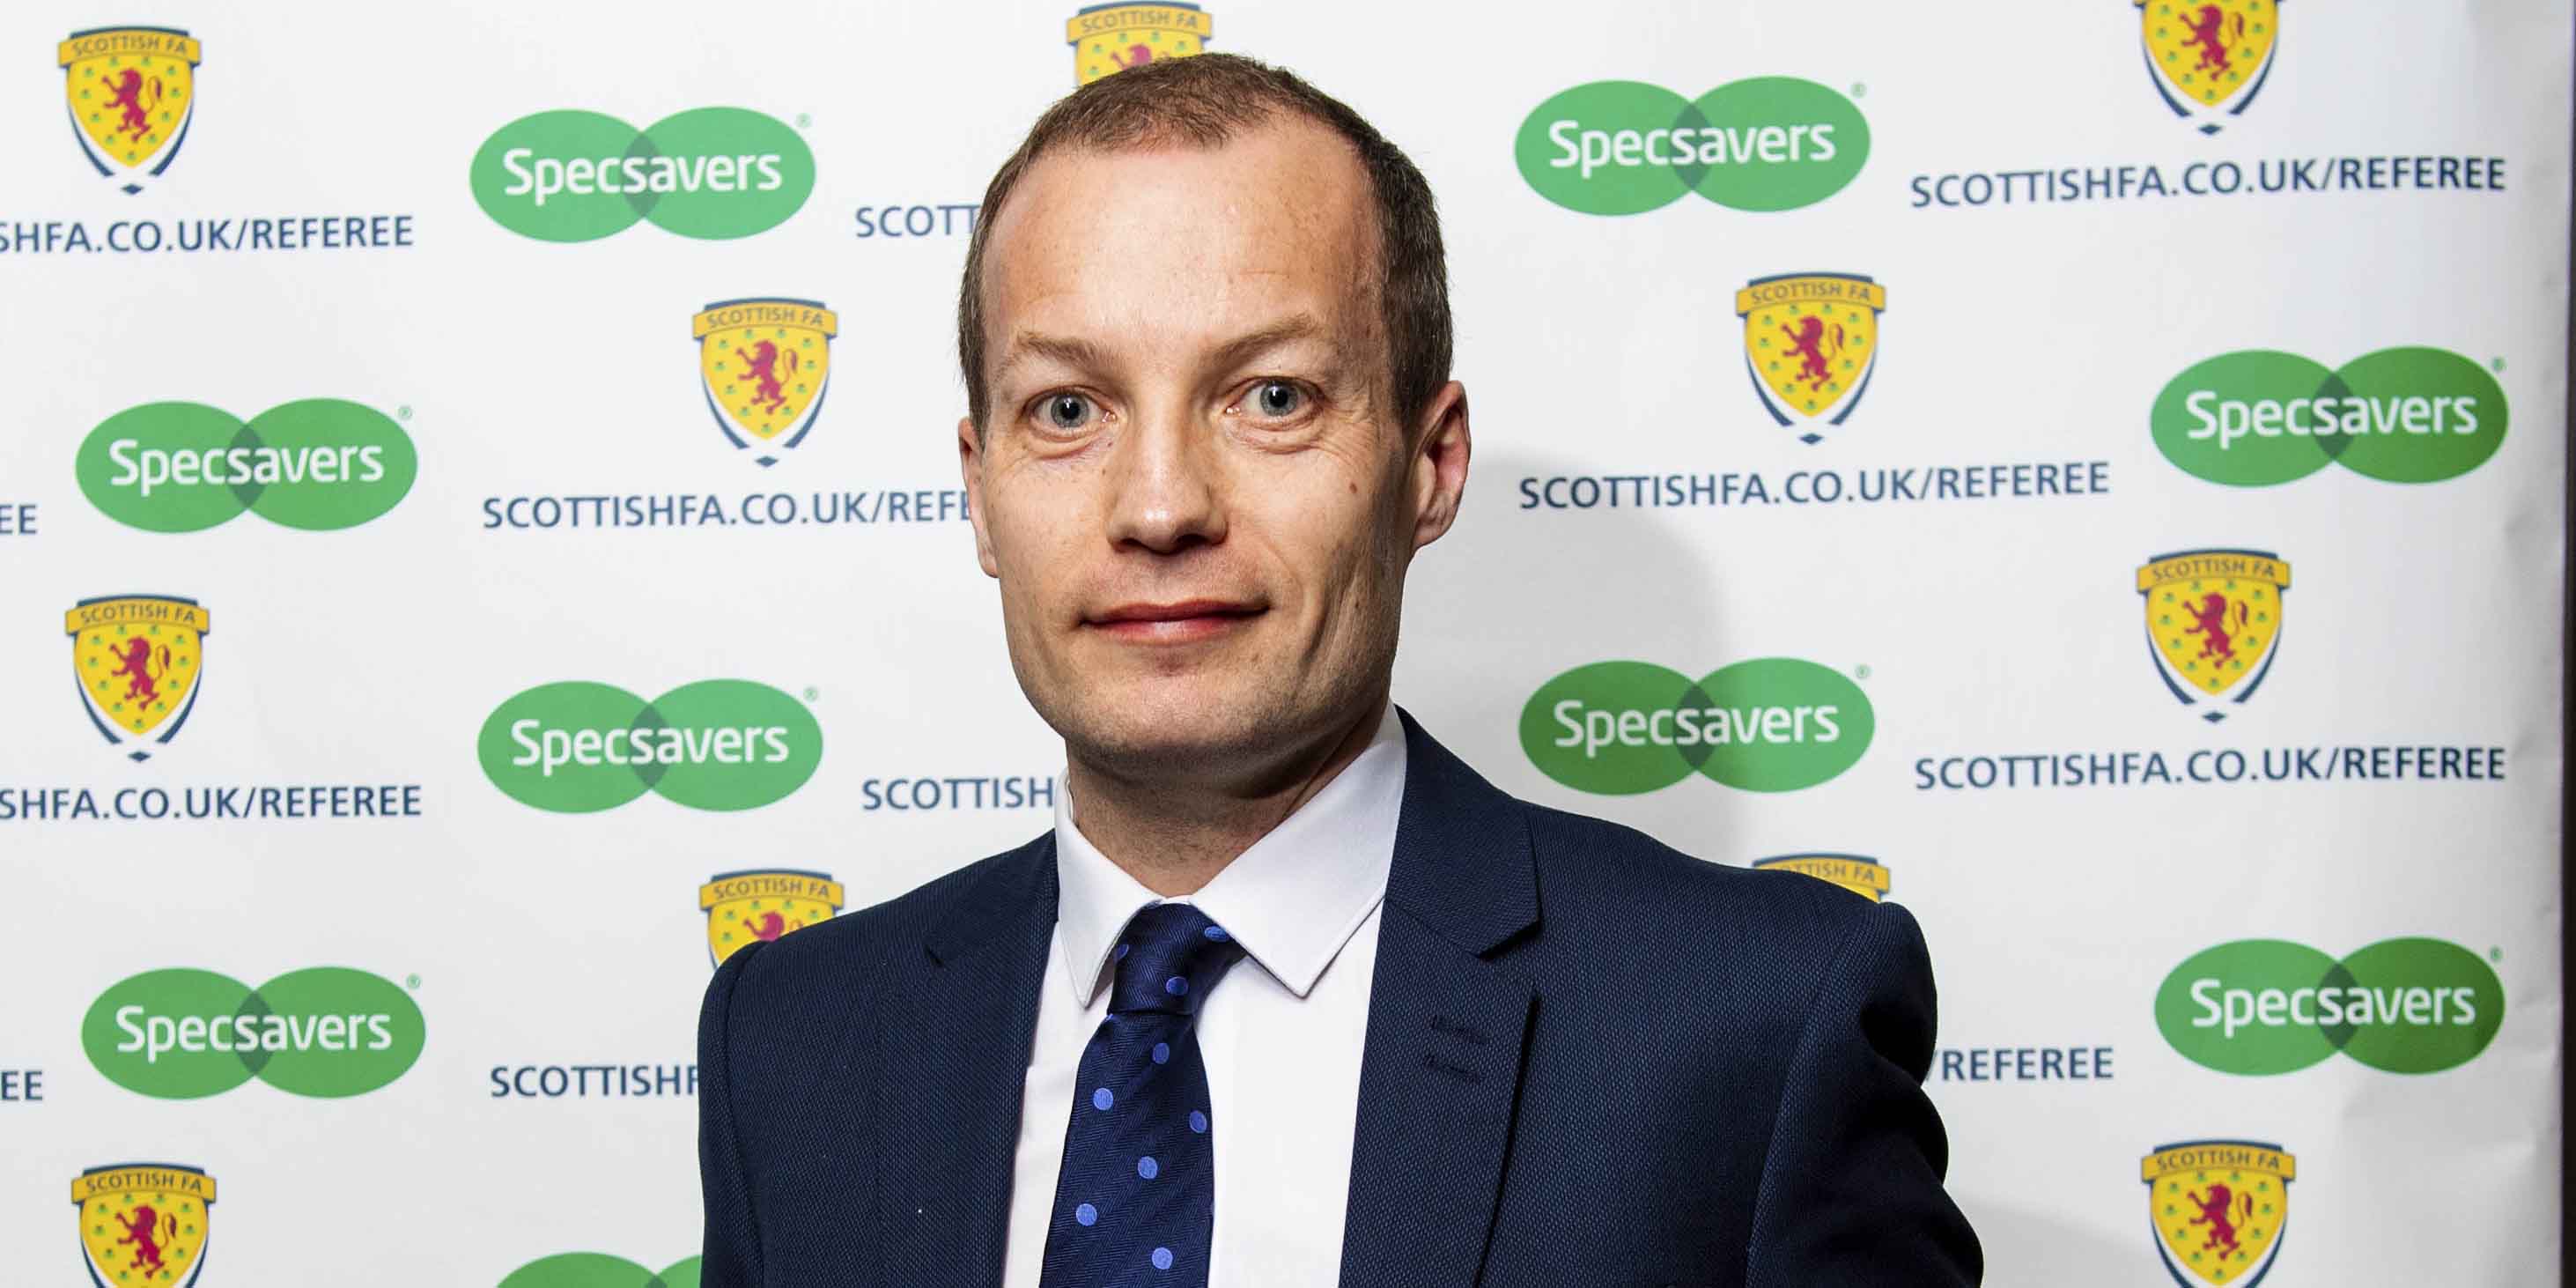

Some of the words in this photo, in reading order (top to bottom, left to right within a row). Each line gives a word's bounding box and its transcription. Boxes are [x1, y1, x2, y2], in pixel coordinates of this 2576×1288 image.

[1081, 10, 1170, 33] SCOTTISH
[1177, 12, 1198, 28] FA
[72, 34, 160, 56] SCOTTISH
[166, 41, 188, 55] FA
[1549, 120, 1835, 179] Specsavers
[503, 147, 783, 206] Specsavers
[1911, 157, 2505, 208] SCOTTISHFA.CO.UK/REFEREE
[1751, 281, 1842, 302] SCOTTISH
[1849, 285, 1871, 300] FA
[706, 307, 795, 329] SCOTTISH
[802, 308, 824, 326] FA
[2186, 390, 2476, 449] Specsavers
[109, 439, 384, 497] Specsavers
[1519, 462, 2108, 509] SCOTTISHFA.CO.UK/REFEREE
[2152, 559, 2246, 581] SCOTTISH
[2255, 561, 2277, 578] FA
[80, 603, 168, 624] SCOTTISH
[175, 607, 196, 624] FA
[512, 719, 789, 776] Specsavers
[1555, 701, 1840, 757] Specsavers
[1915, 747, 2505, 789] SCOTTISHFA.CO.UK/REFEREE
[862, 777, 1053, 811] SCOTTISH
[713, 878, 802, 899] SCOTTISH
[808, 882, 830, 898] FA
[1854, 864, 1875, 882] FA
[2191, 979, 2475, 1038] Specsavers
[116, 1005, 392, 1062] Specsavers
[2158, 1150, 2250, 1171] SCOTTISH
[2258, 1153, 2280, 1170] FA
[85, 1173, 174, 1193] SCOTTISH
[181, 1176, 203, 1193] FA
